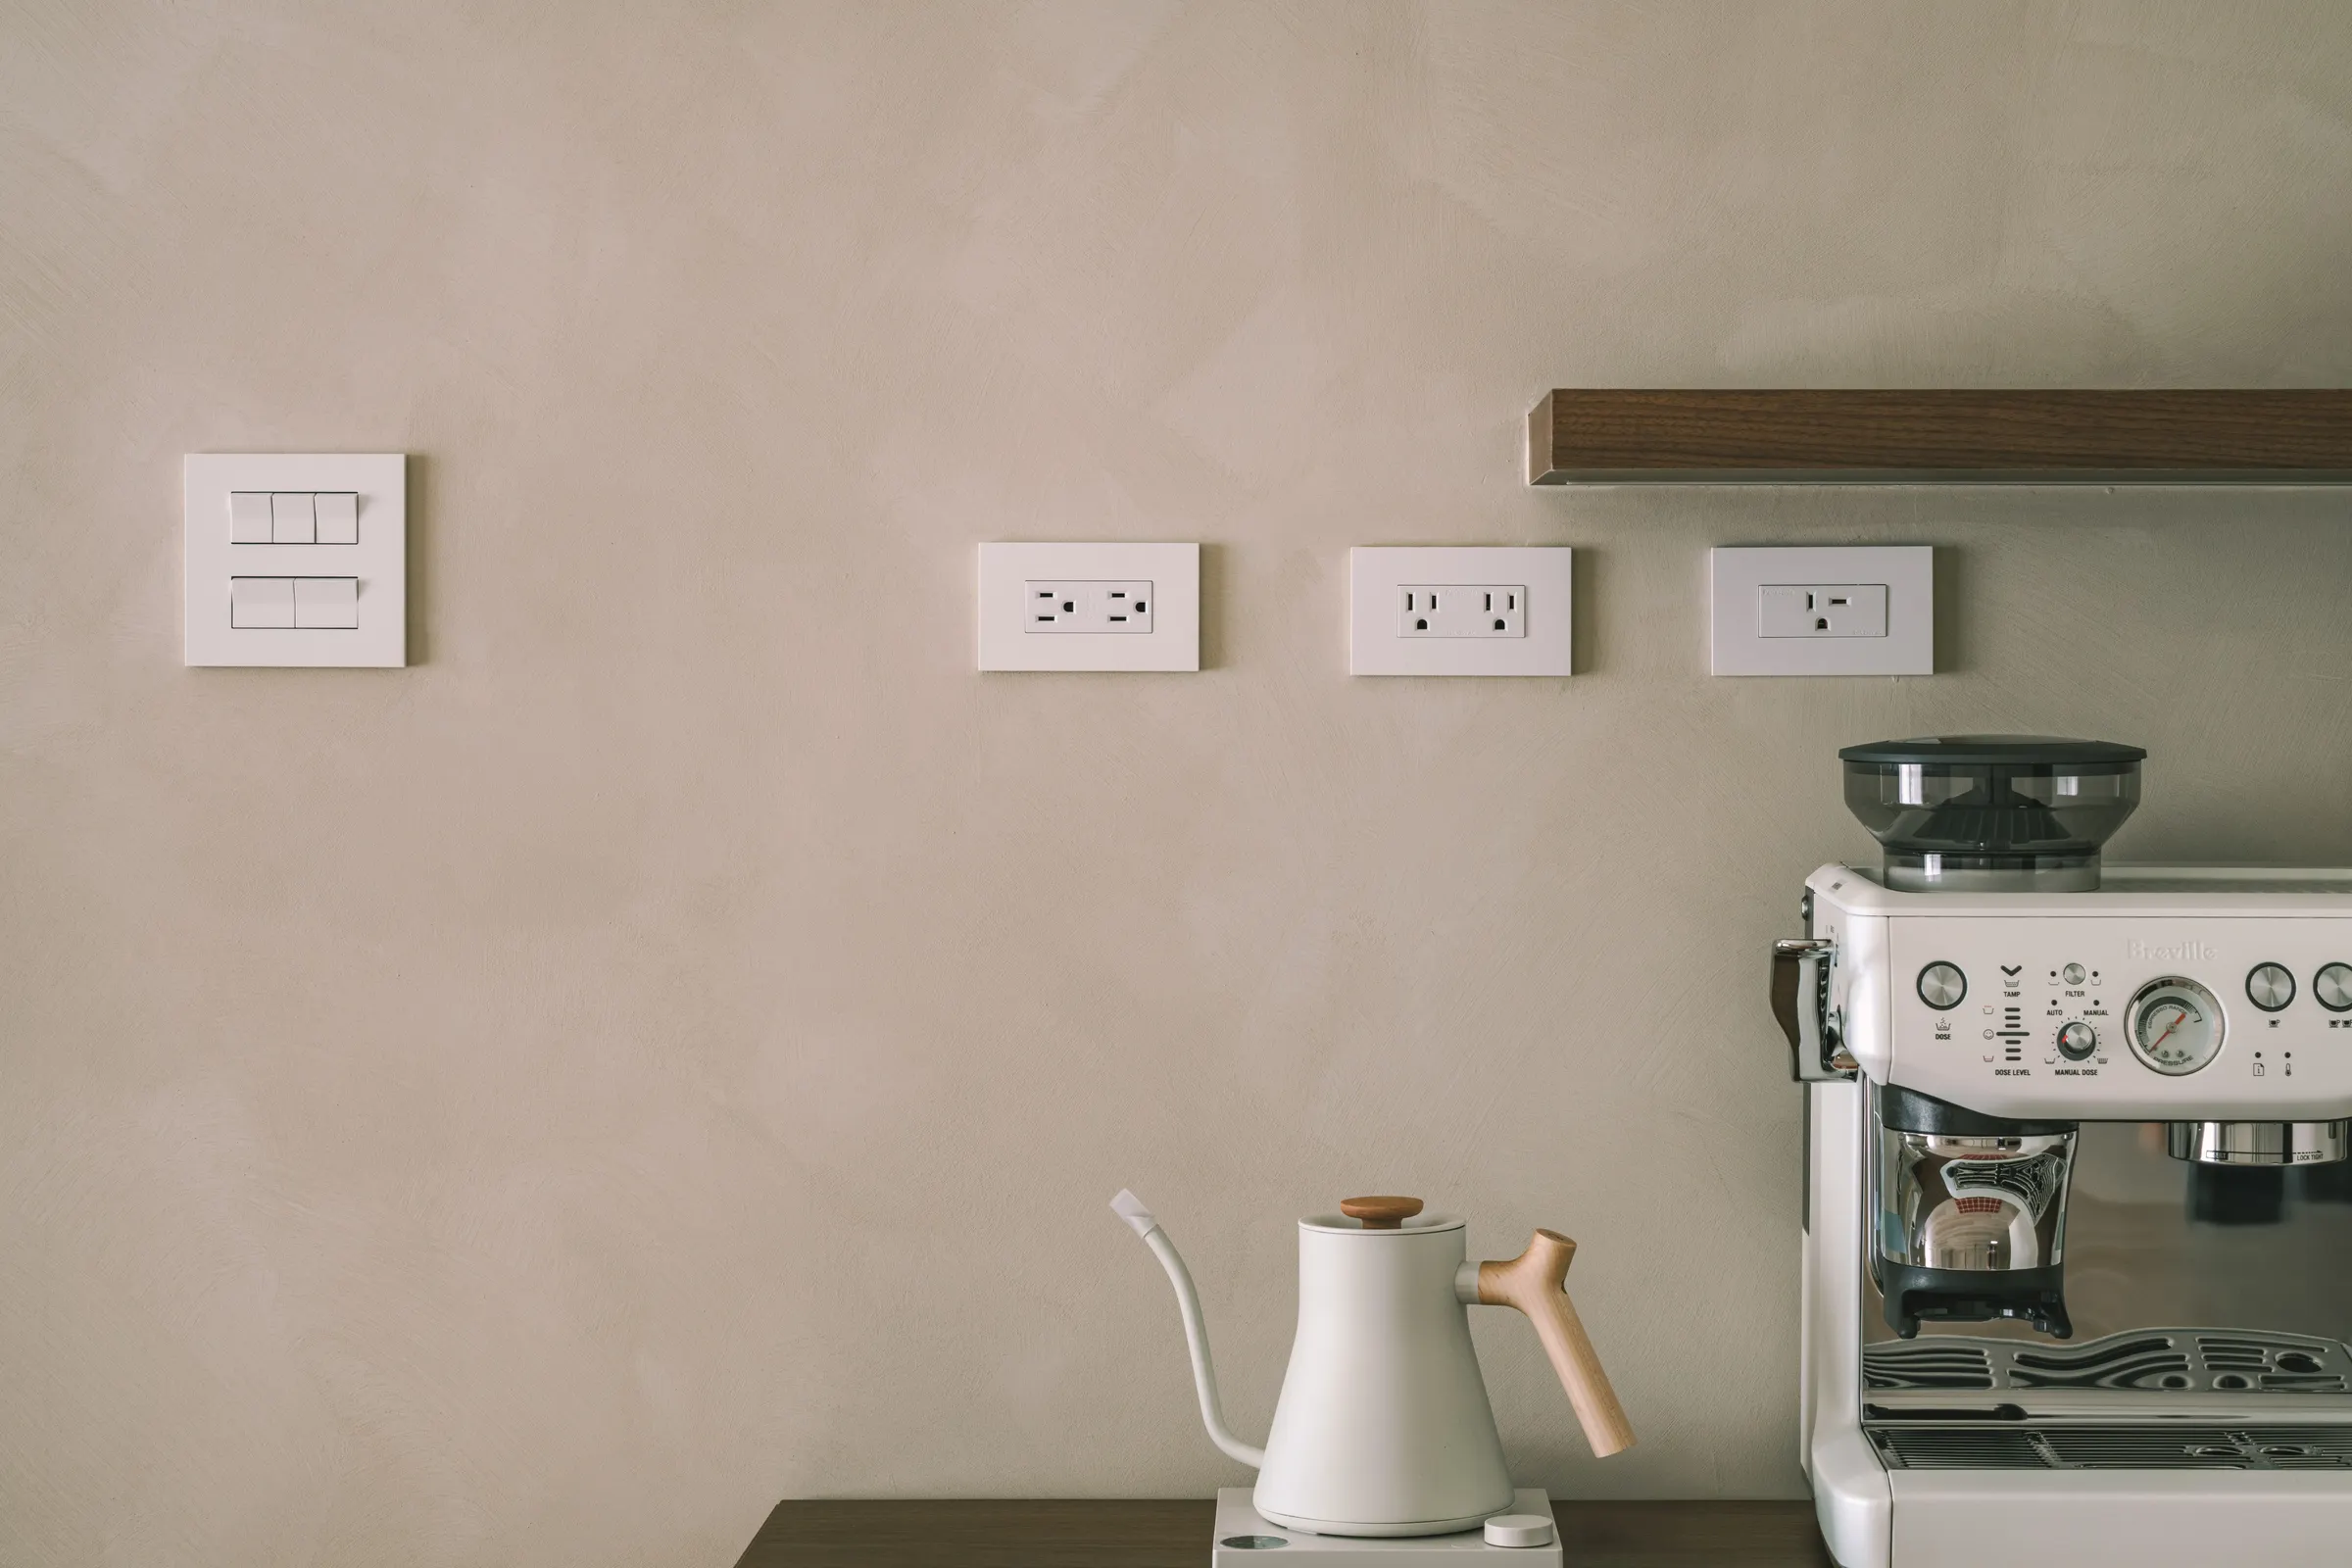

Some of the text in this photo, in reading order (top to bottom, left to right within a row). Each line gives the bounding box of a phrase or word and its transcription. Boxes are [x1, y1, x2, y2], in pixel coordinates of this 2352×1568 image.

[2127, 937, 2219, 960] Breville
[2147, 1004, 2168, 1029] ESPRESSO
[2153, 1054, 2194, 1066] PRESSURE
